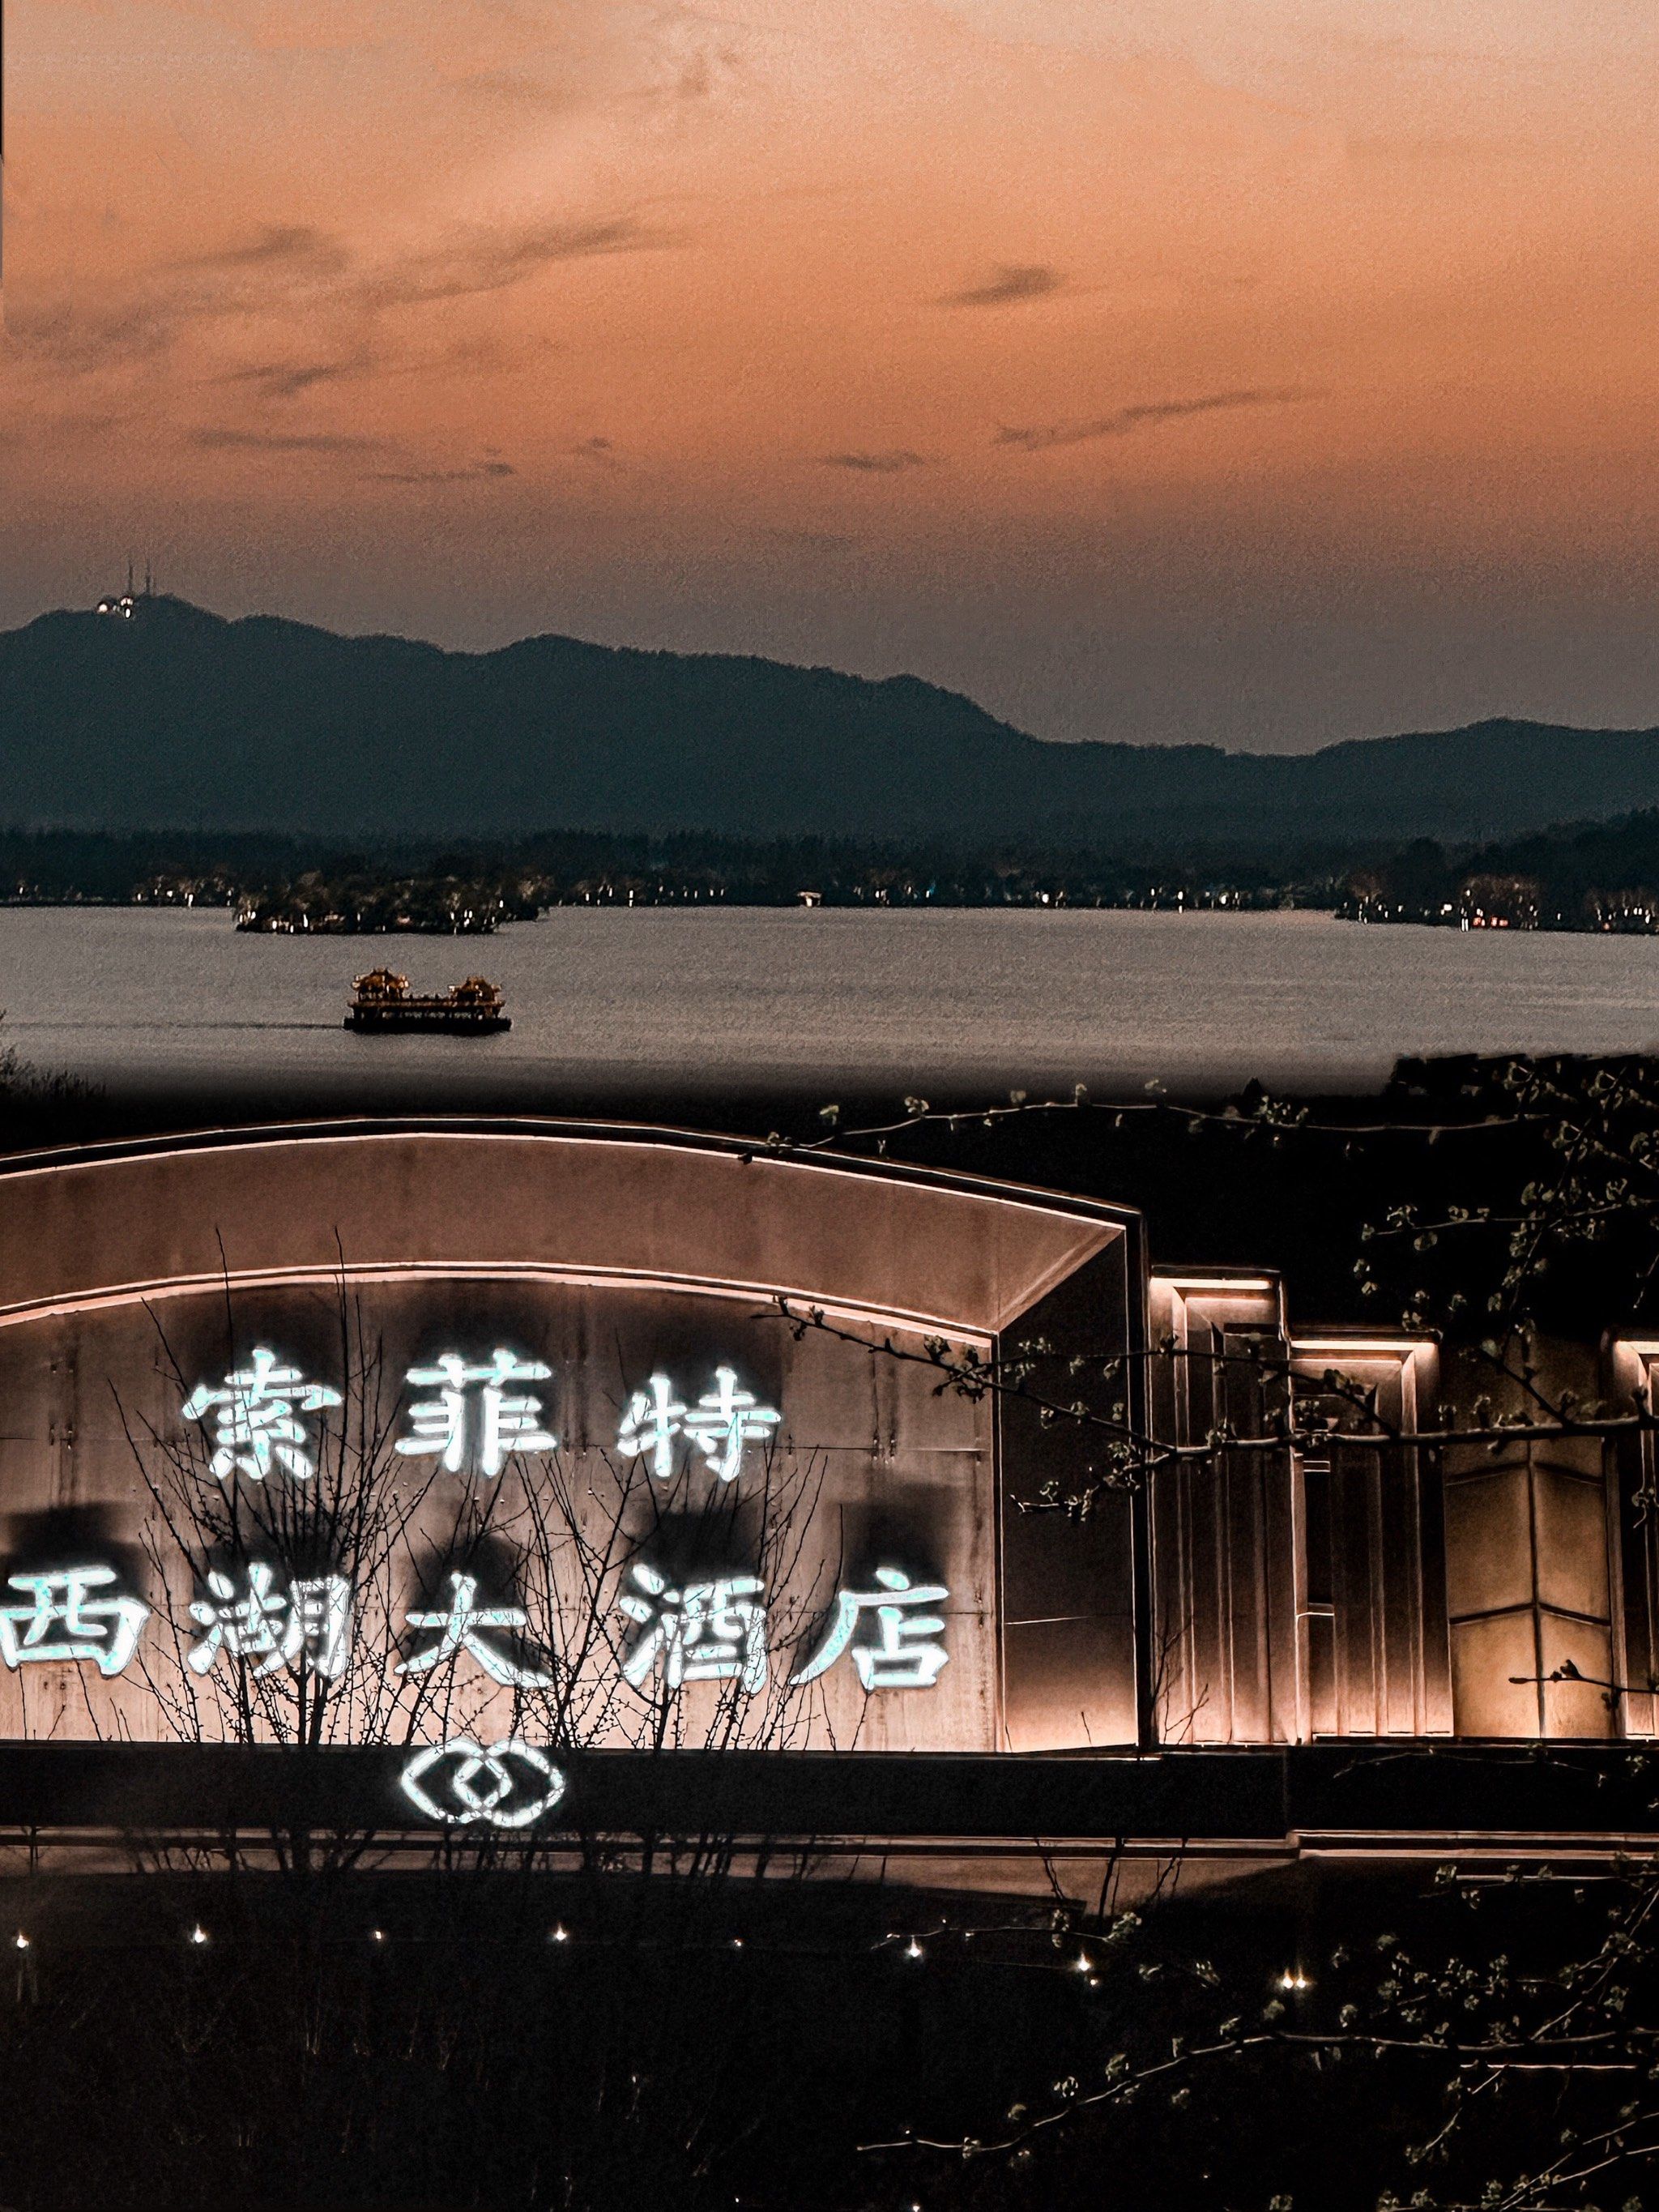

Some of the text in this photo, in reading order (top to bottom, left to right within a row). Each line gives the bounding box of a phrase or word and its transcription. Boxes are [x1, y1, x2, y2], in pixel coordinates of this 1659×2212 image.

[183, 1347, 782, 1482] 索菲特
[0, 1565, 949, 1693] 西湖大酒店
